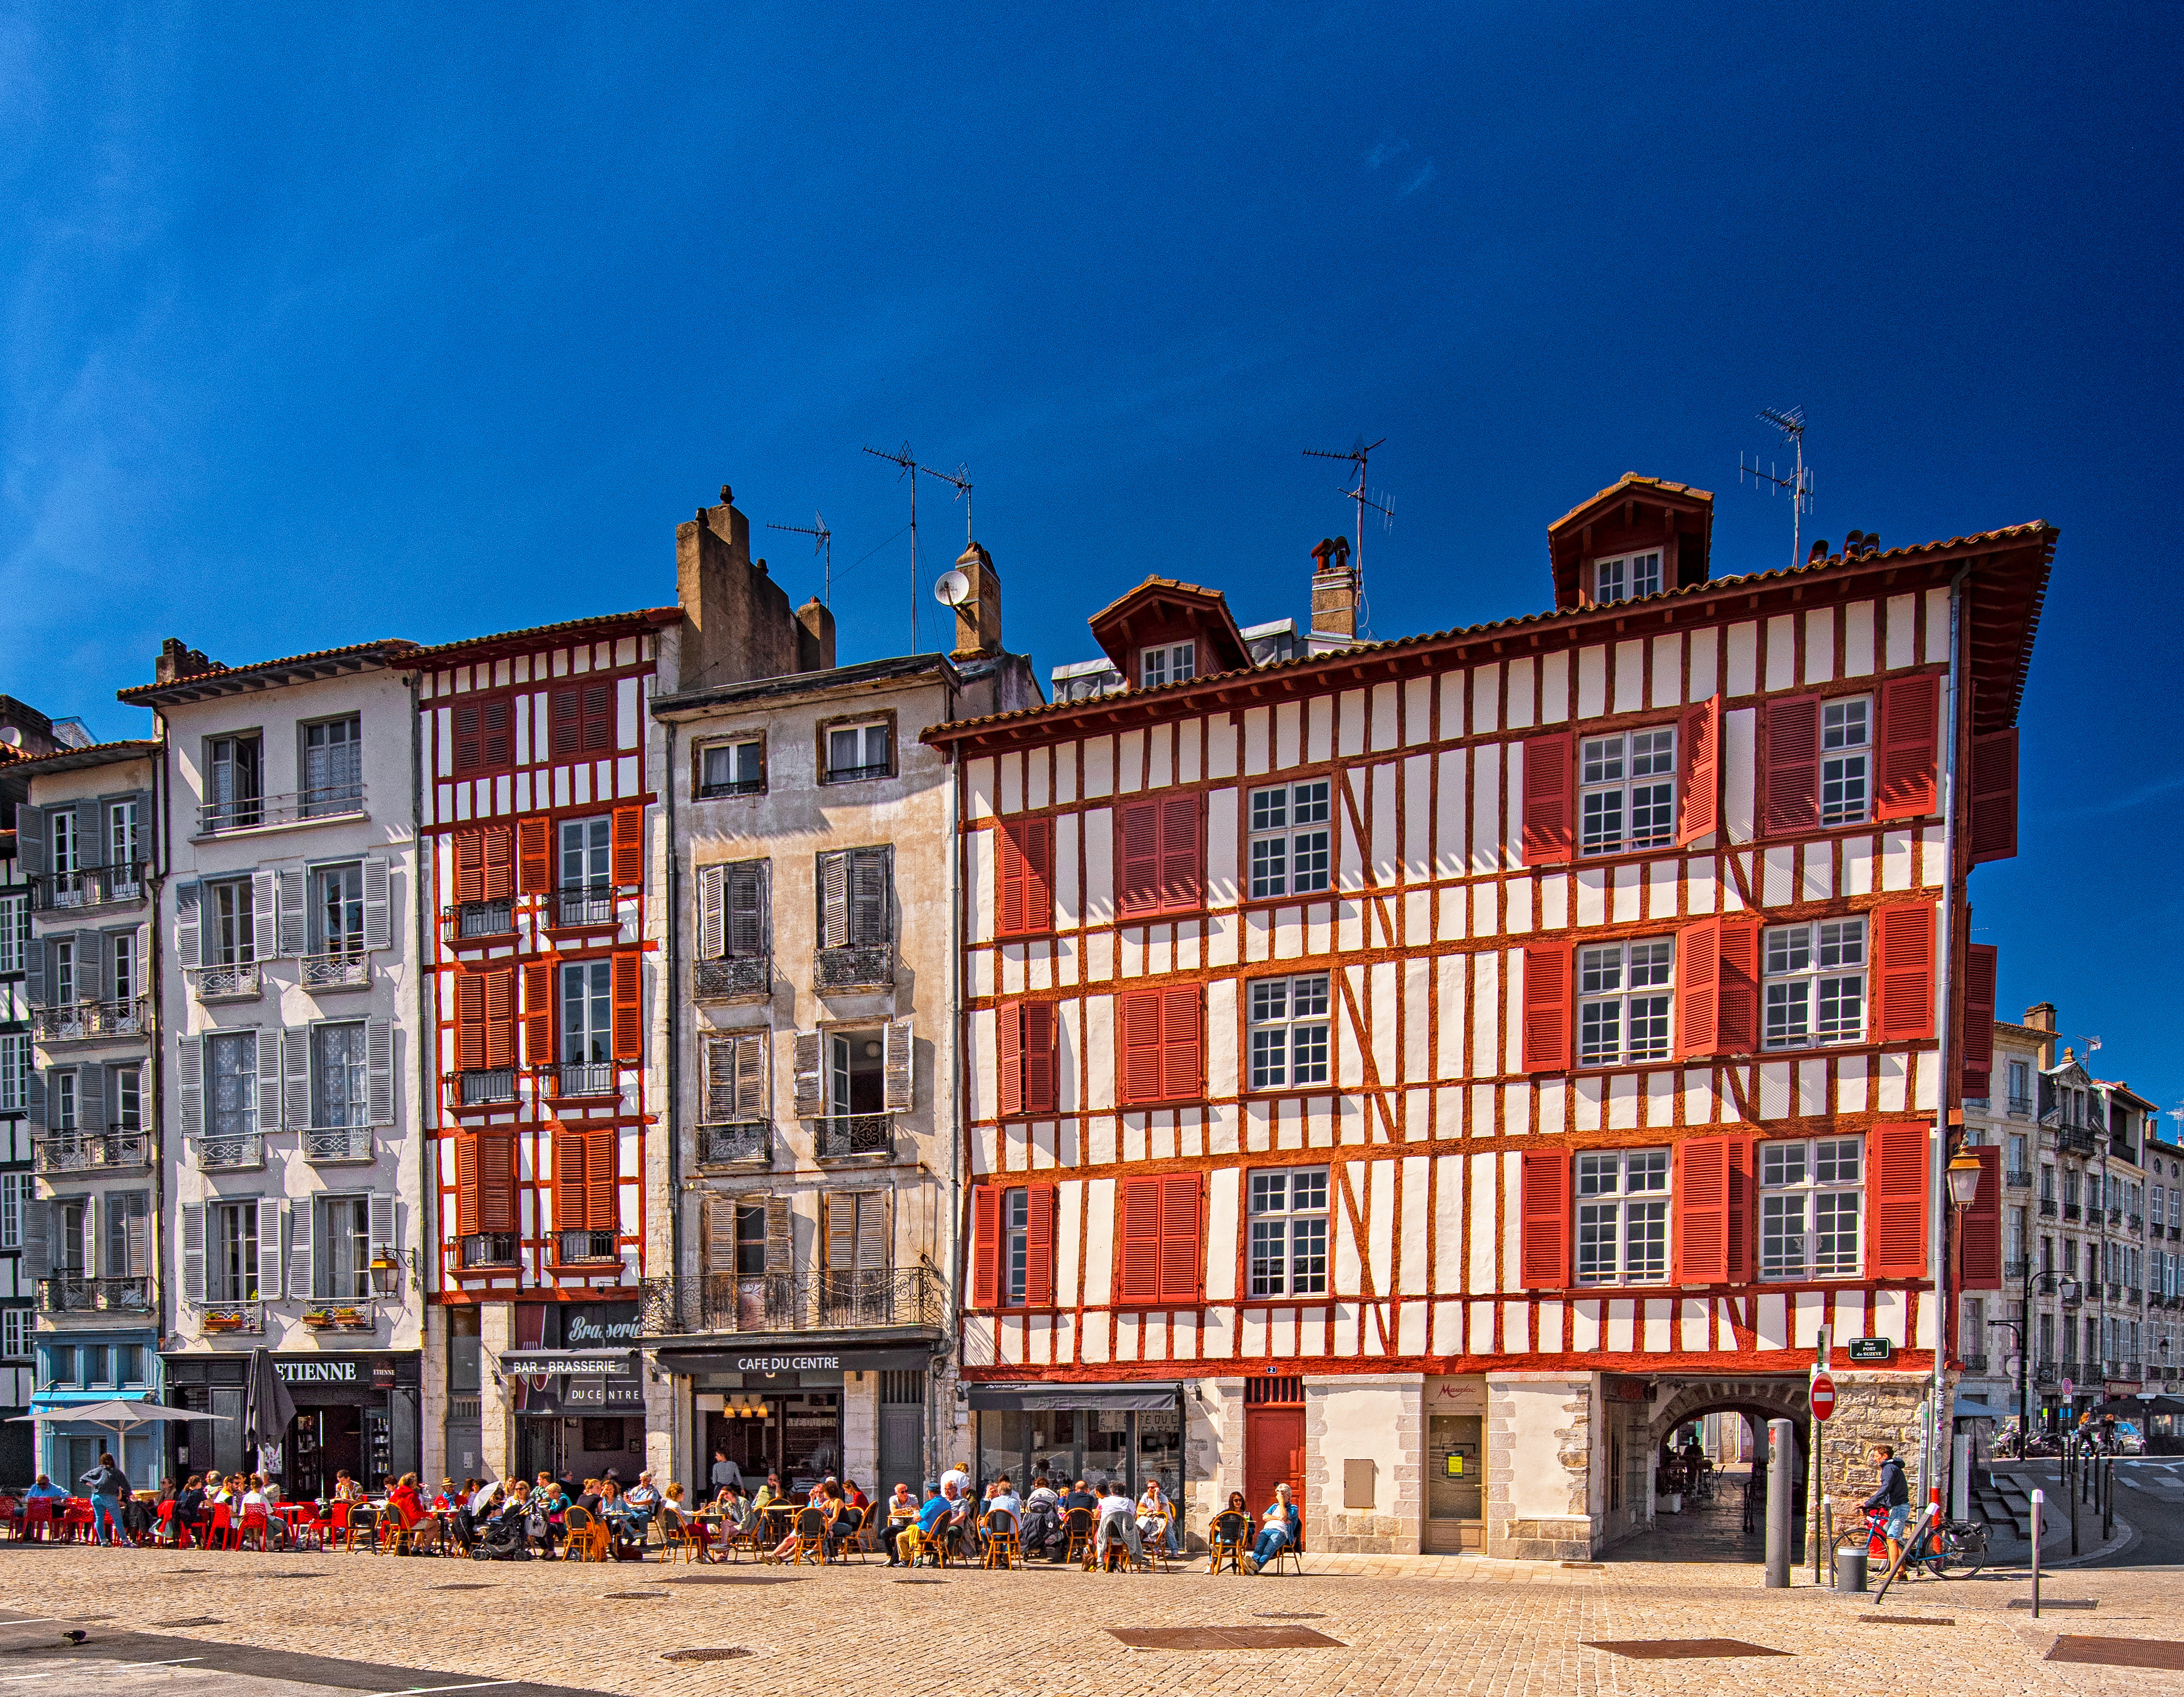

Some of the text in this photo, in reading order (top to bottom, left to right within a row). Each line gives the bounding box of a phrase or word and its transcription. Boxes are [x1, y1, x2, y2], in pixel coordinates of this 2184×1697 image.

[513, 1362, 538, 1373] BAR
[548, 1360, 616, 1372] BRASSERIE
[738, 1357, 839, 1370] CAFE DU CENTRE
[275, 1362, 357, 1380] ETIENNE
[572, 1391, 585, 1399] DU
[1436, 1383, 1477, 1400] Mauriac
